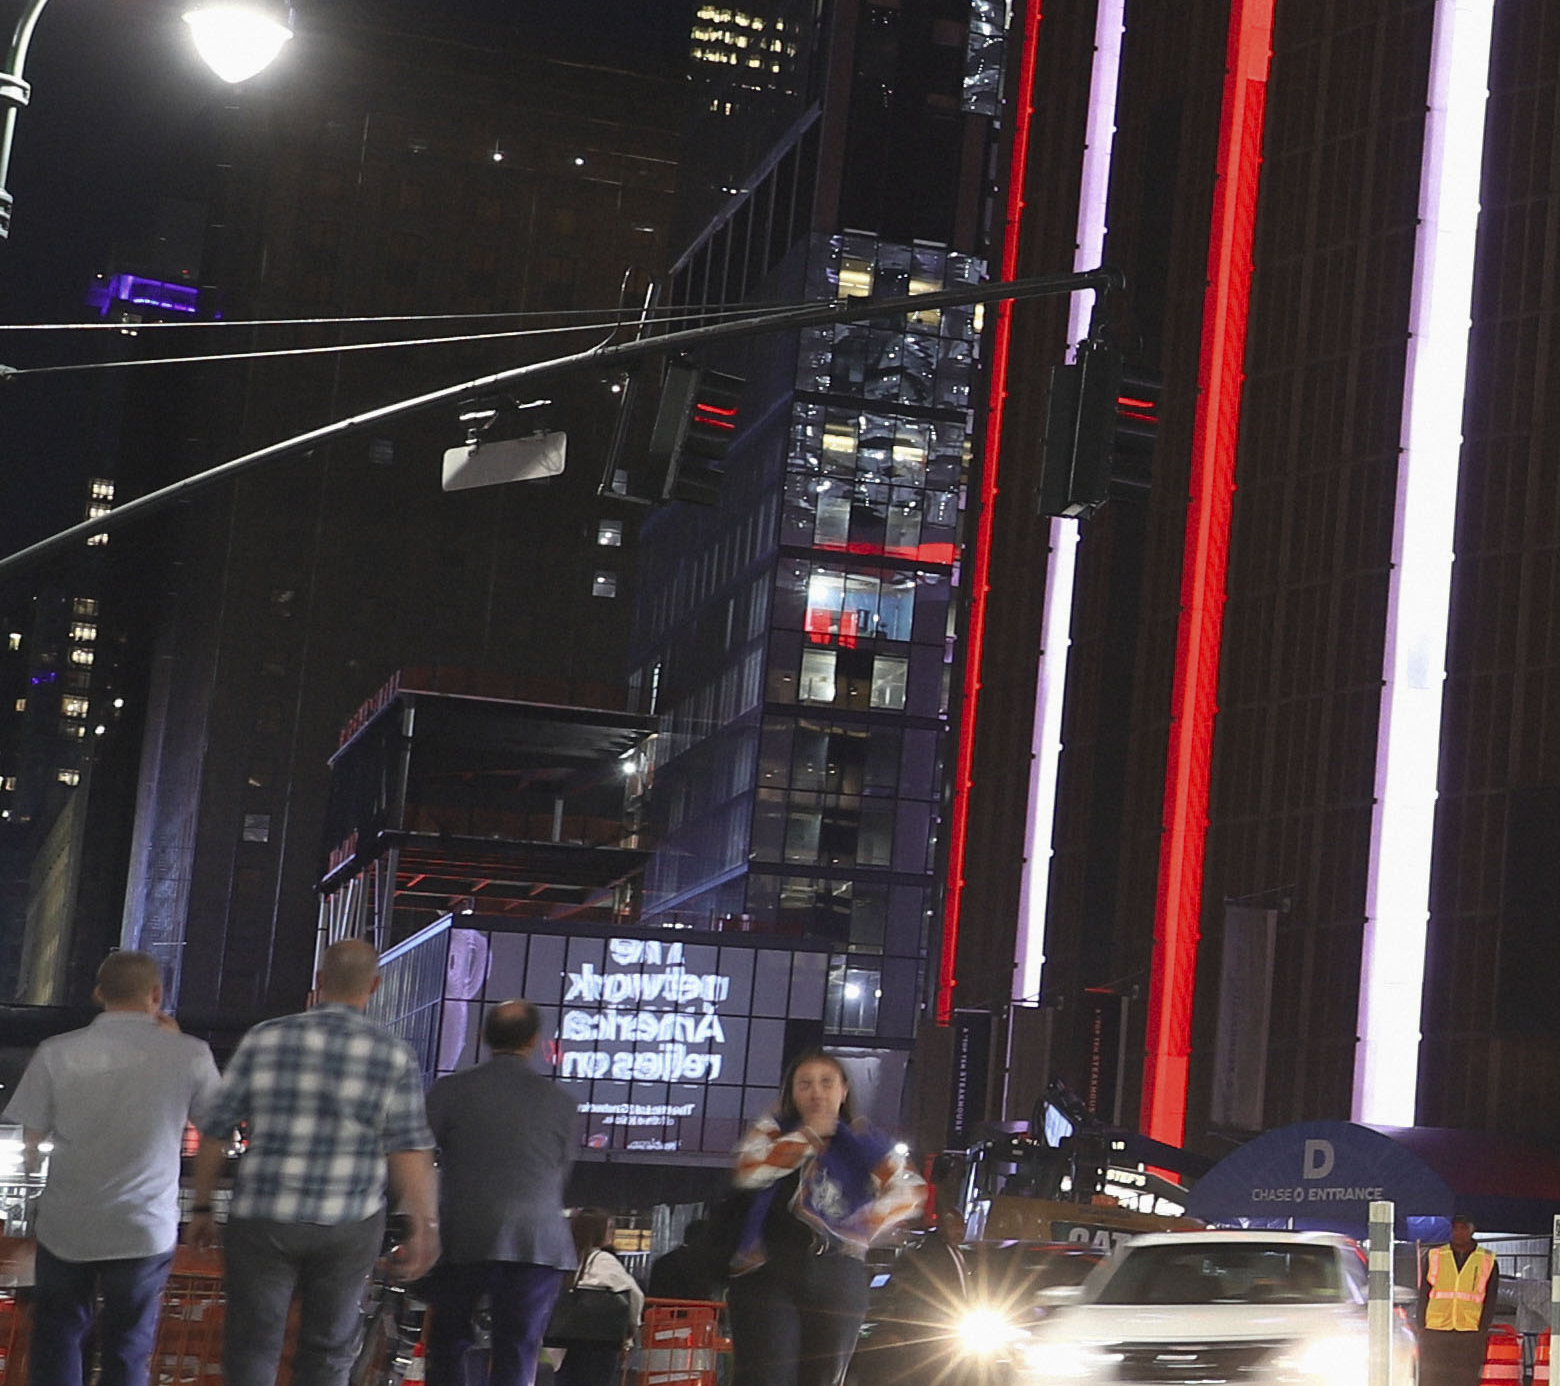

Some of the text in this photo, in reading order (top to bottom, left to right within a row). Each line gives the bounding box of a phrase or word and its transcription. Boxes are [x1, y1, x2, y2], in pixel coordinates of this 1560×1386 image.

[1304, 1139, 1335, 1179] D
[1252, 1188, 1384, 1202] CHASE ENTRANCE
